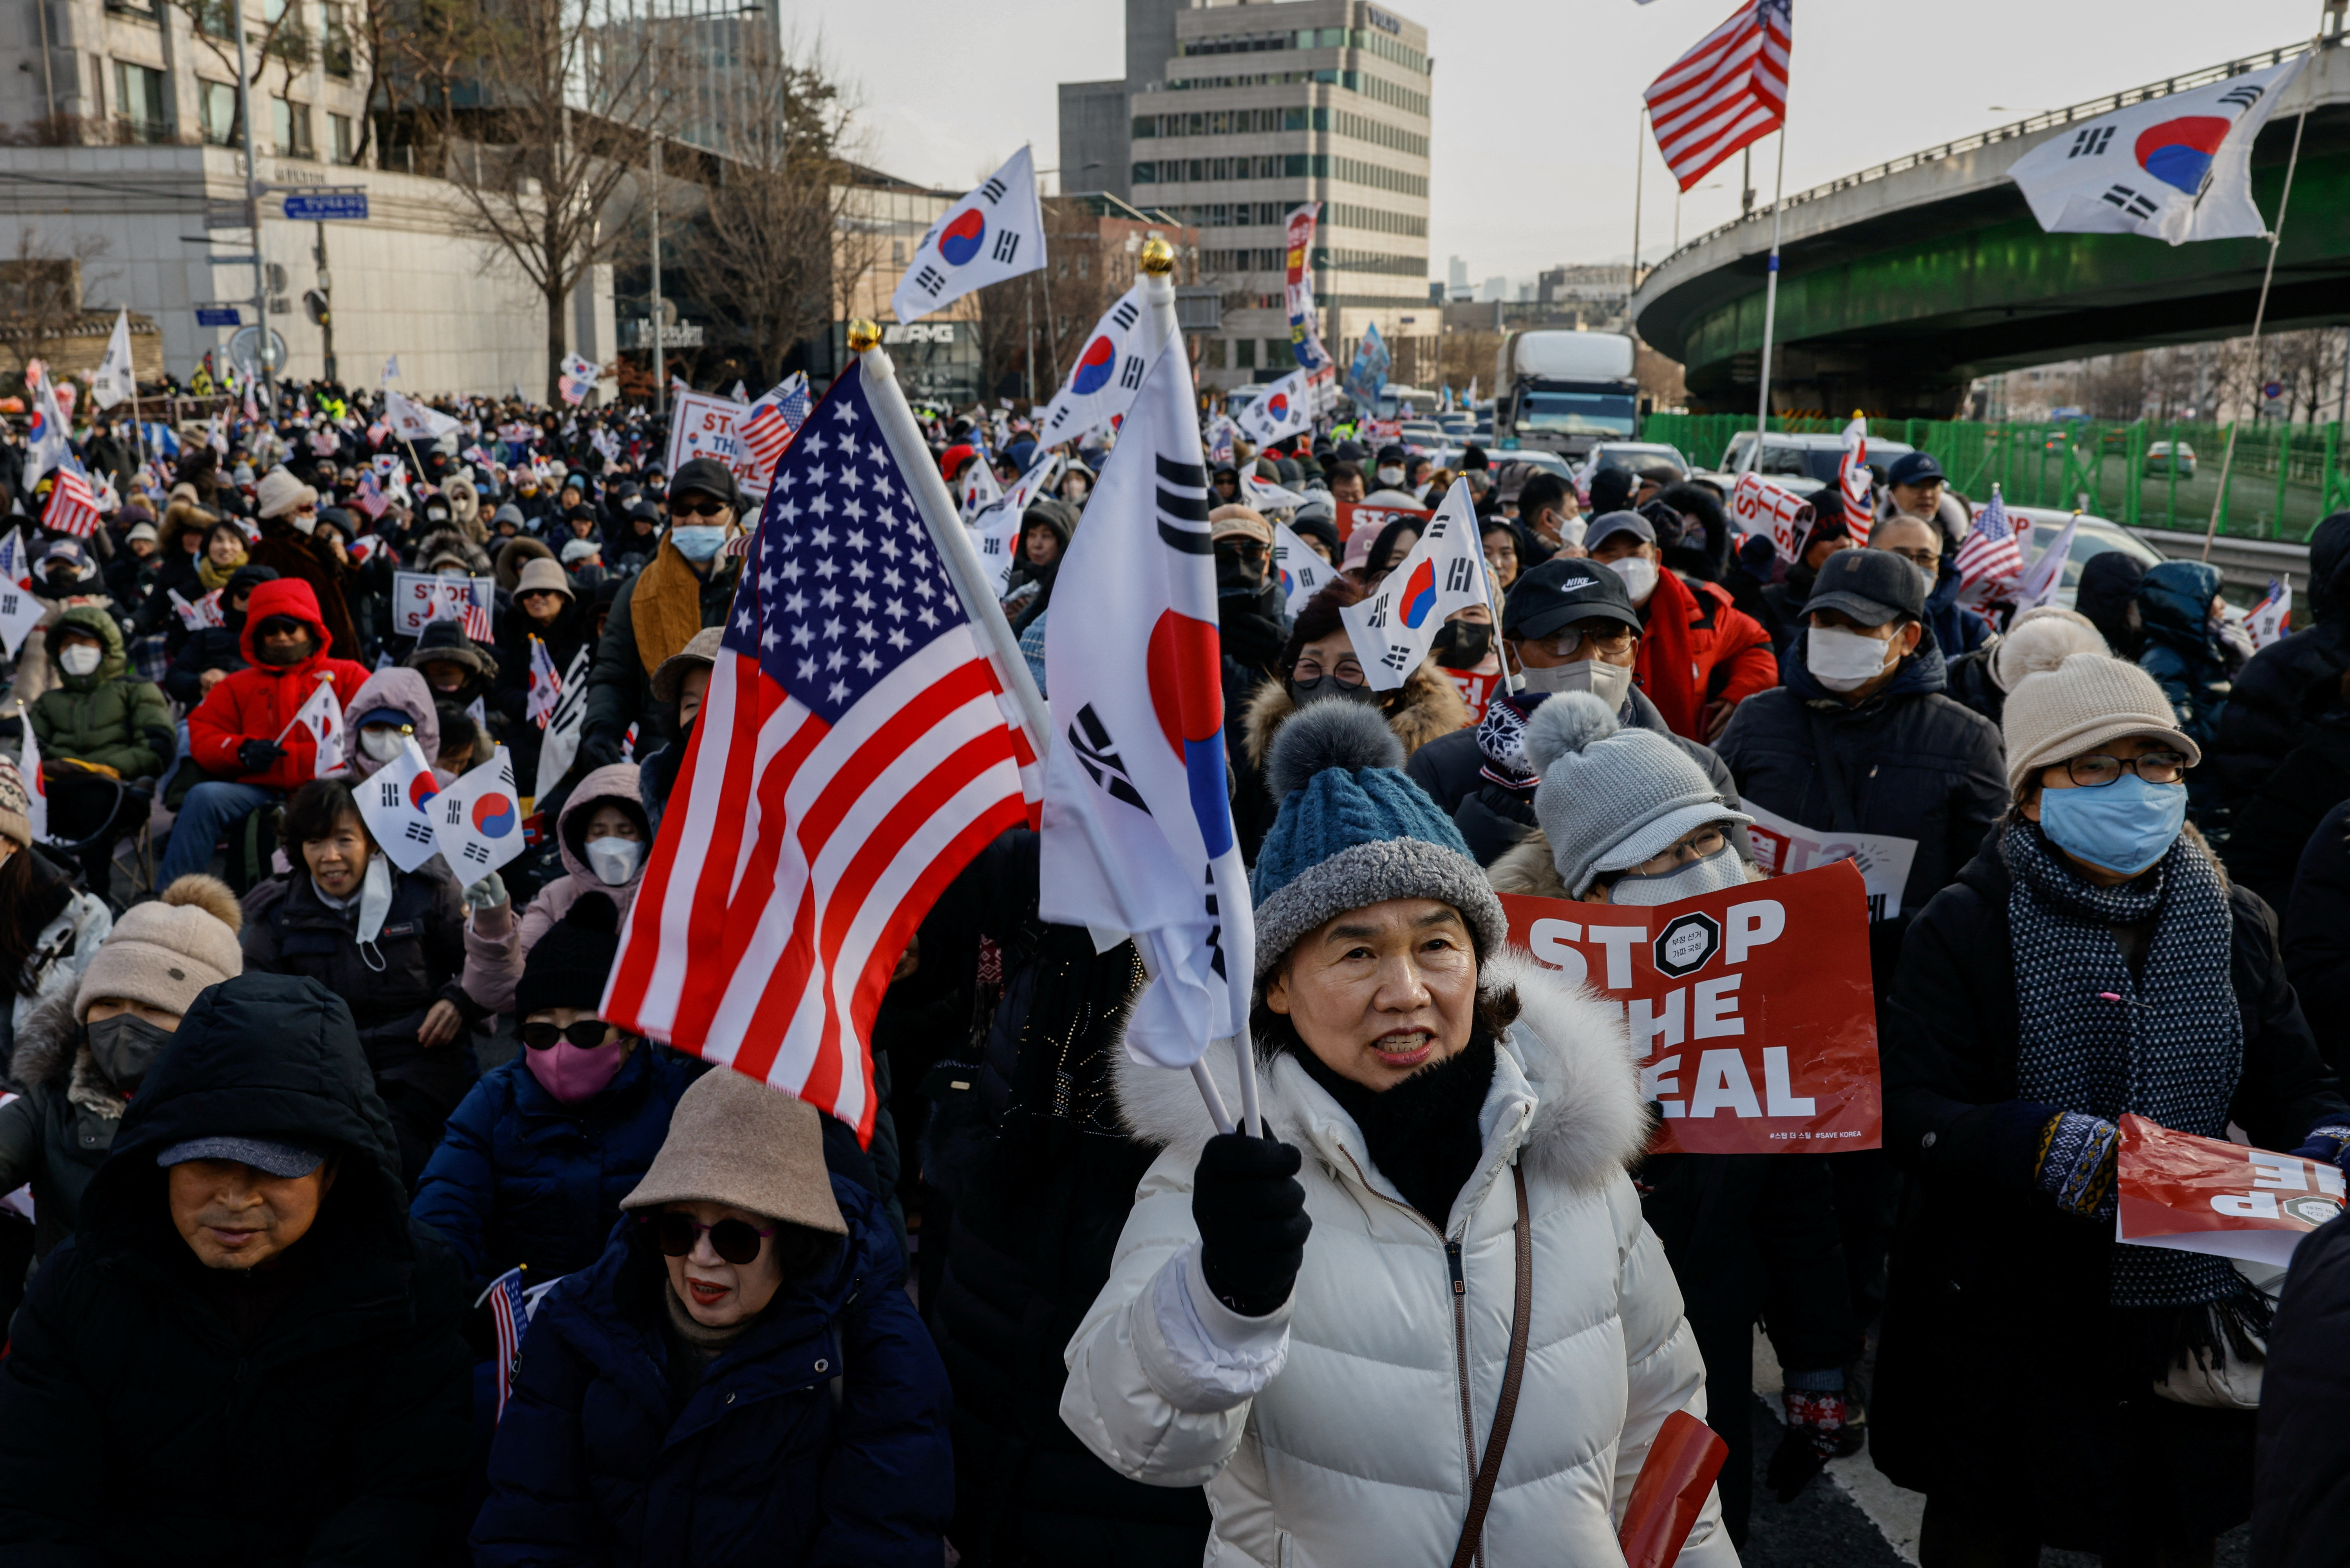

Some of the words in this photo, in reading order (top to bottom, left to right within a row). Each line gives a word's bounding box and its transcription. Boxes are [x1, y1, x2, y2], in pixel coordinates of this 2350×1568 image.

[906, 324, 954, 343] AMG
[713, 435, 737, 454] TH
[1567, 577, 1589, 586] NIKE
[1530, 899, 1786, 989] STOP
[1672, 935, 1685, 946] 부정
[1688, 931, 1701, 941] 선거
[1673, 948, 1686, 958] 가짜
[1688, 942, 1701, 952] 국회
[1590, 973, 1745, 1060] HE
[1640, 1047, 1816, 1118] EAL
